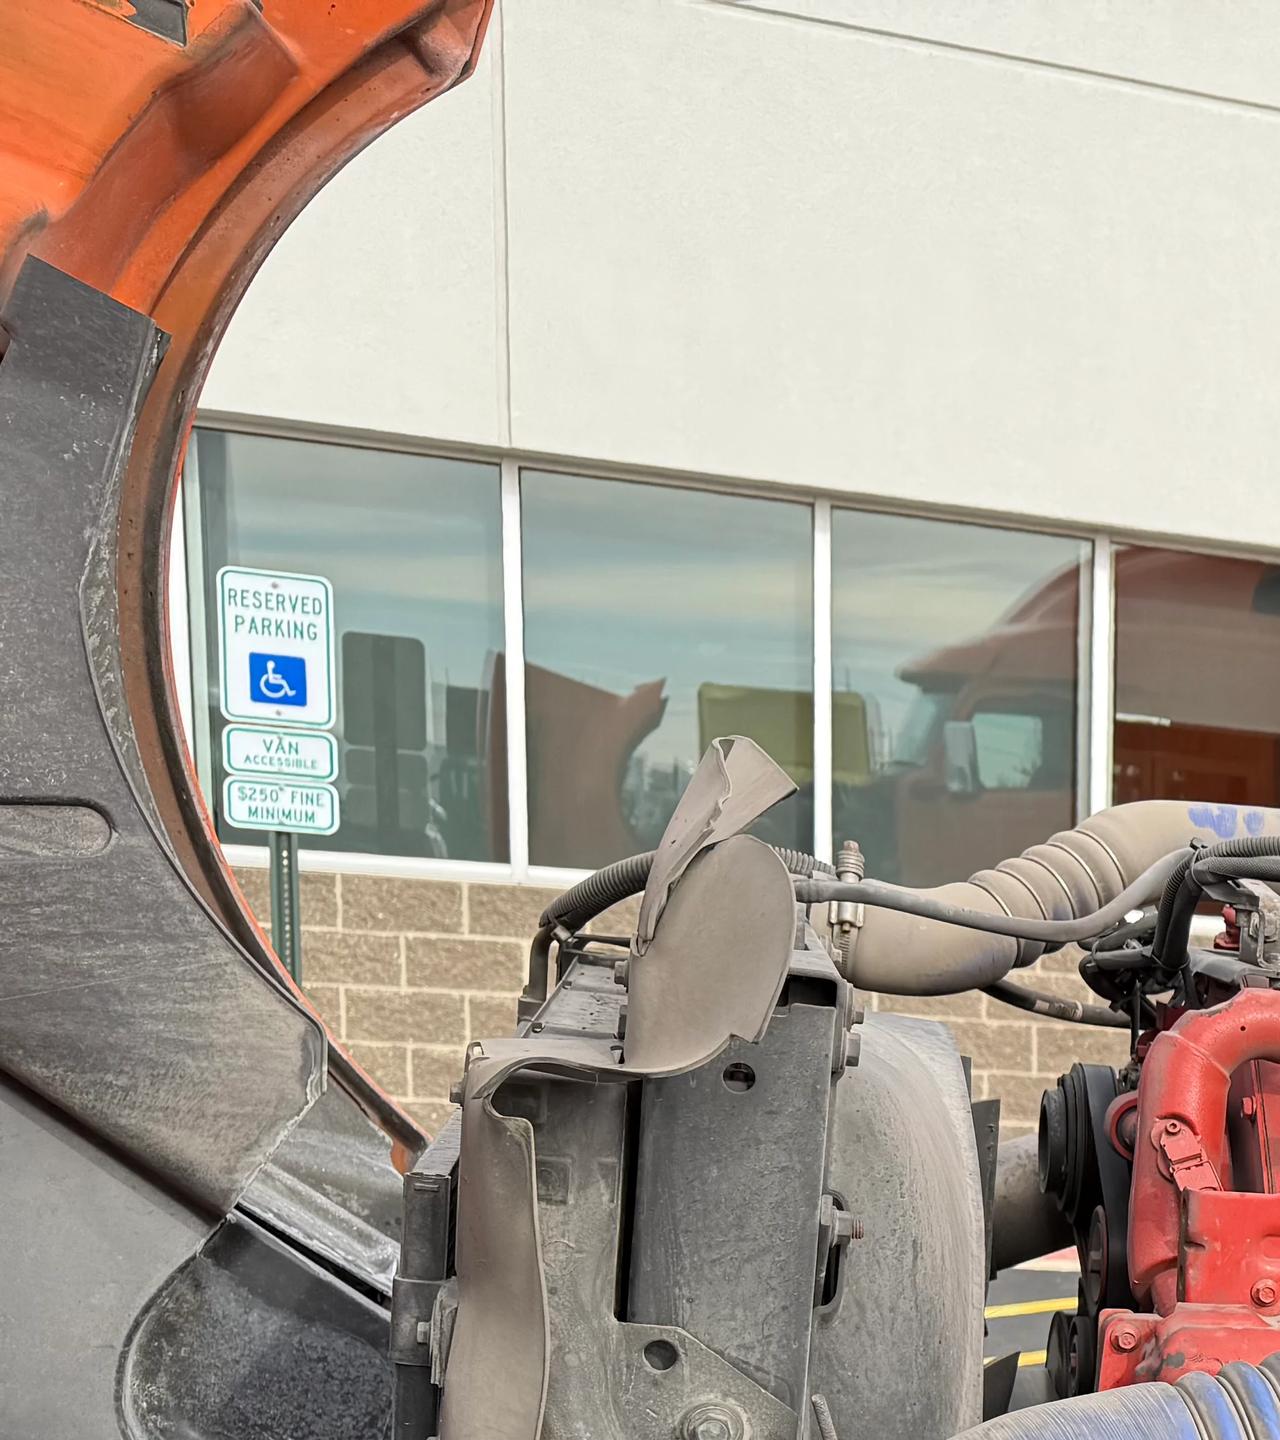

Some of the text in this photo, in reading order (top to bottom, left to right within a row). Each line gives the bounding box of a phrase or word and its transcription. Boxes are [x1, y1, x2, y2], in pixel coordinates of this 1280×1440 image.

[228, 588, 322, 616] RESERVED
[234, 615, 318, 641] PARKING
[263, 739, 299, 755] VAN
[244, 755, 318, 770] ACCESSIBLE
[237, 786, 325, 807] $250 FINE
[248, 806, 316, 823] MINIMUM
